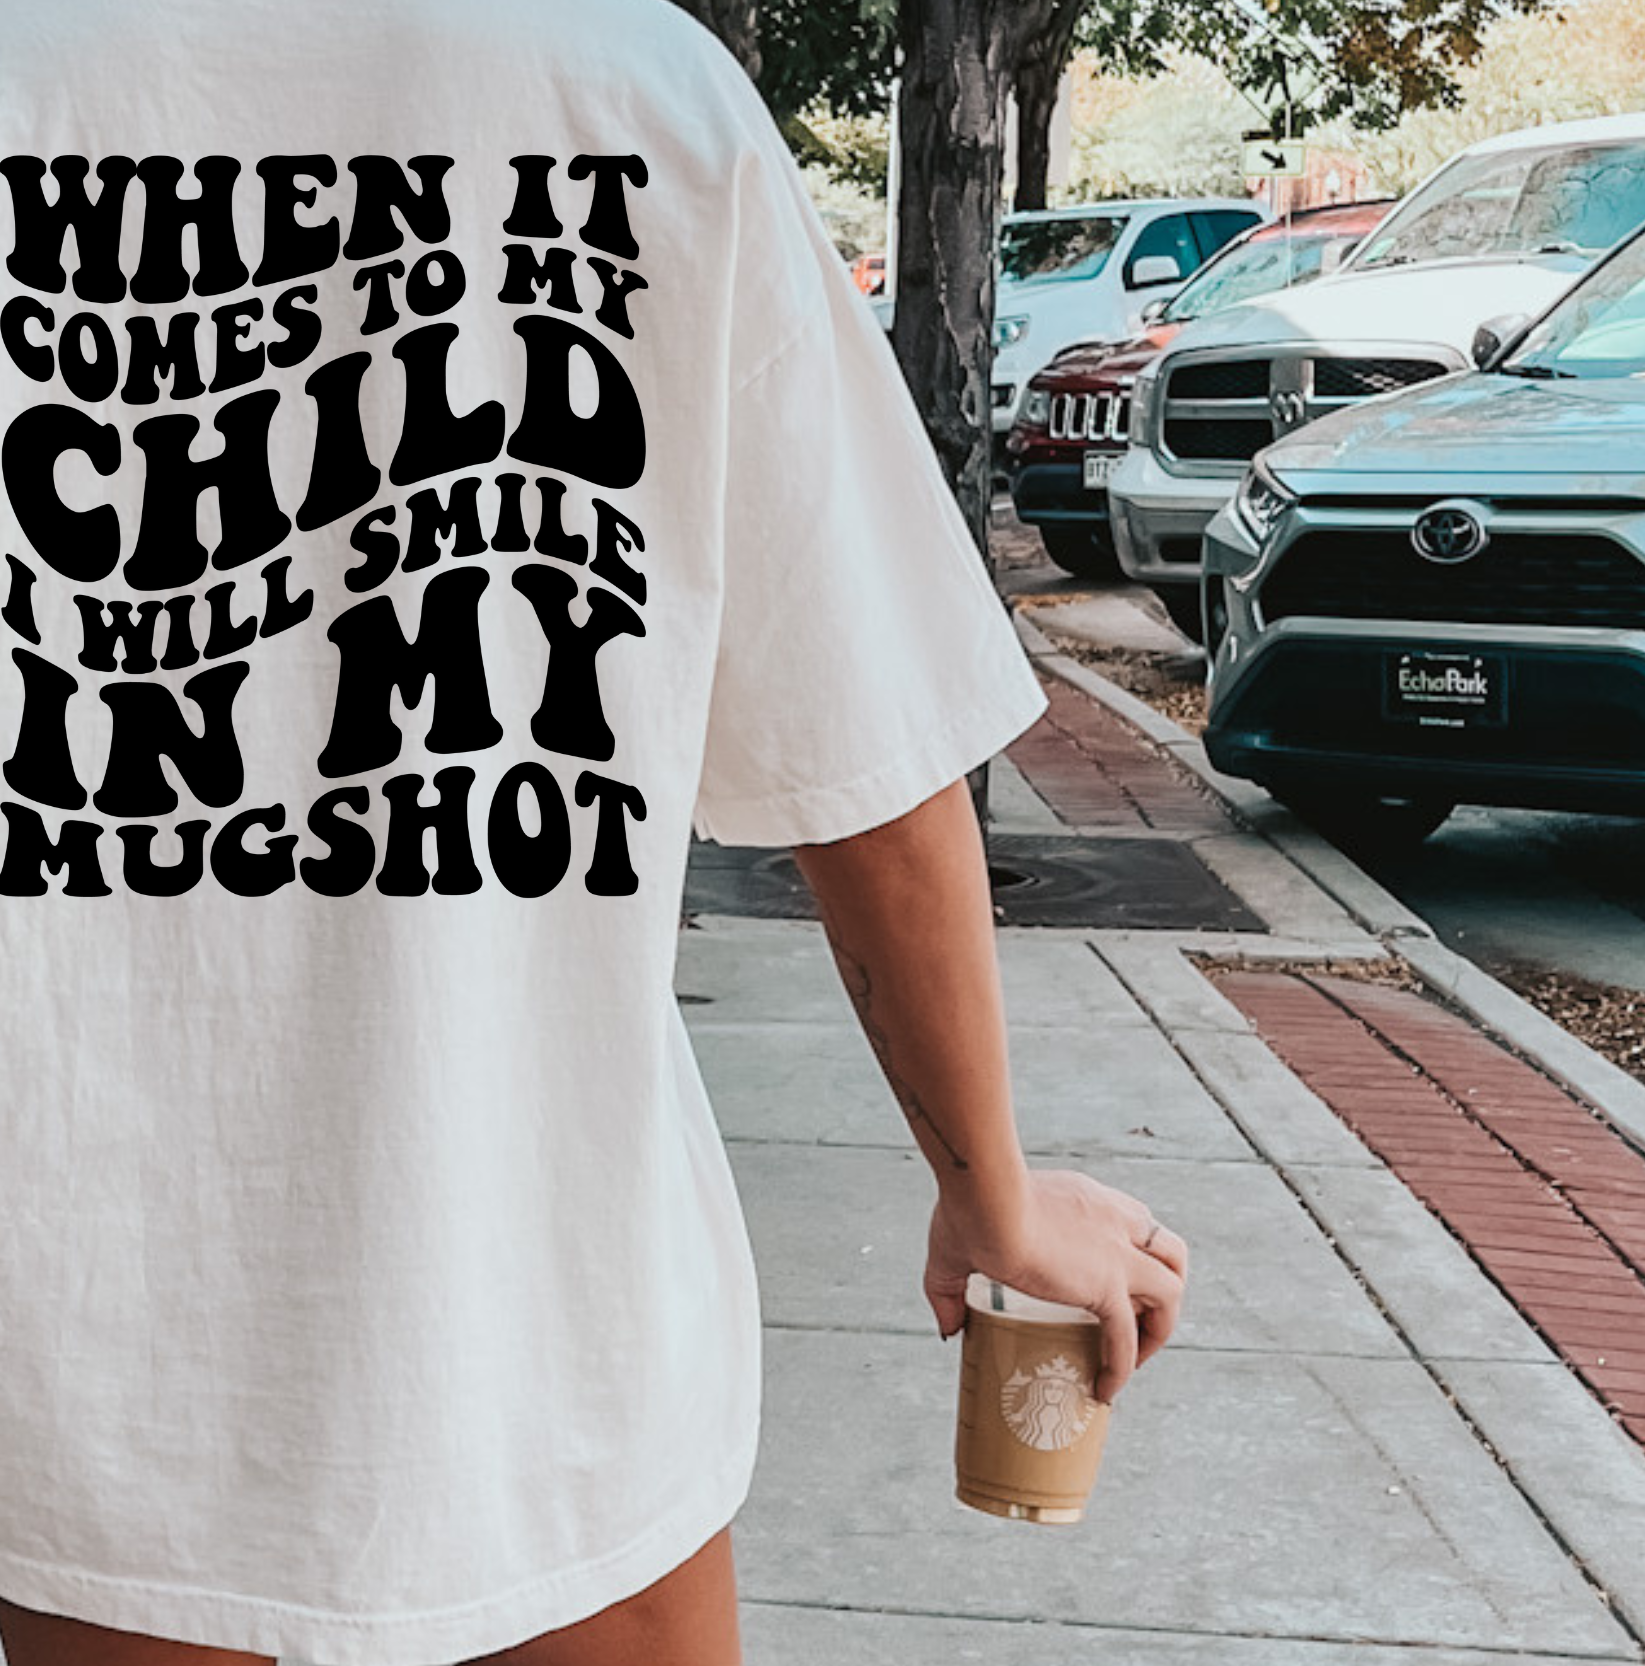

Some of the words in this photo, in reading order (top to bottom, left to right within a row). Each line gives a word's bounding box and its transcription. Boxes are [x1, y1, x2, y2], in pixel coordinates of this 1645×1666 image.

[0, 155, 454, 303] WHEN
[503, 155, 648, 260] IT
[1, 284, 321, 404] COMES
[353, 250, 465, 335] TO
[498, 244, 648, 339] MY
[2, 315, 646, 591] CHILD
[2, 554, 41, 645] I
[74, 556, 313, 674] WILL
[345, 473, 646, 605] SMILE
[3, 648, 249, 817] IN
[318, 564, 646, 778] MY
[1398, 668, 1488, 694] EchoPark
